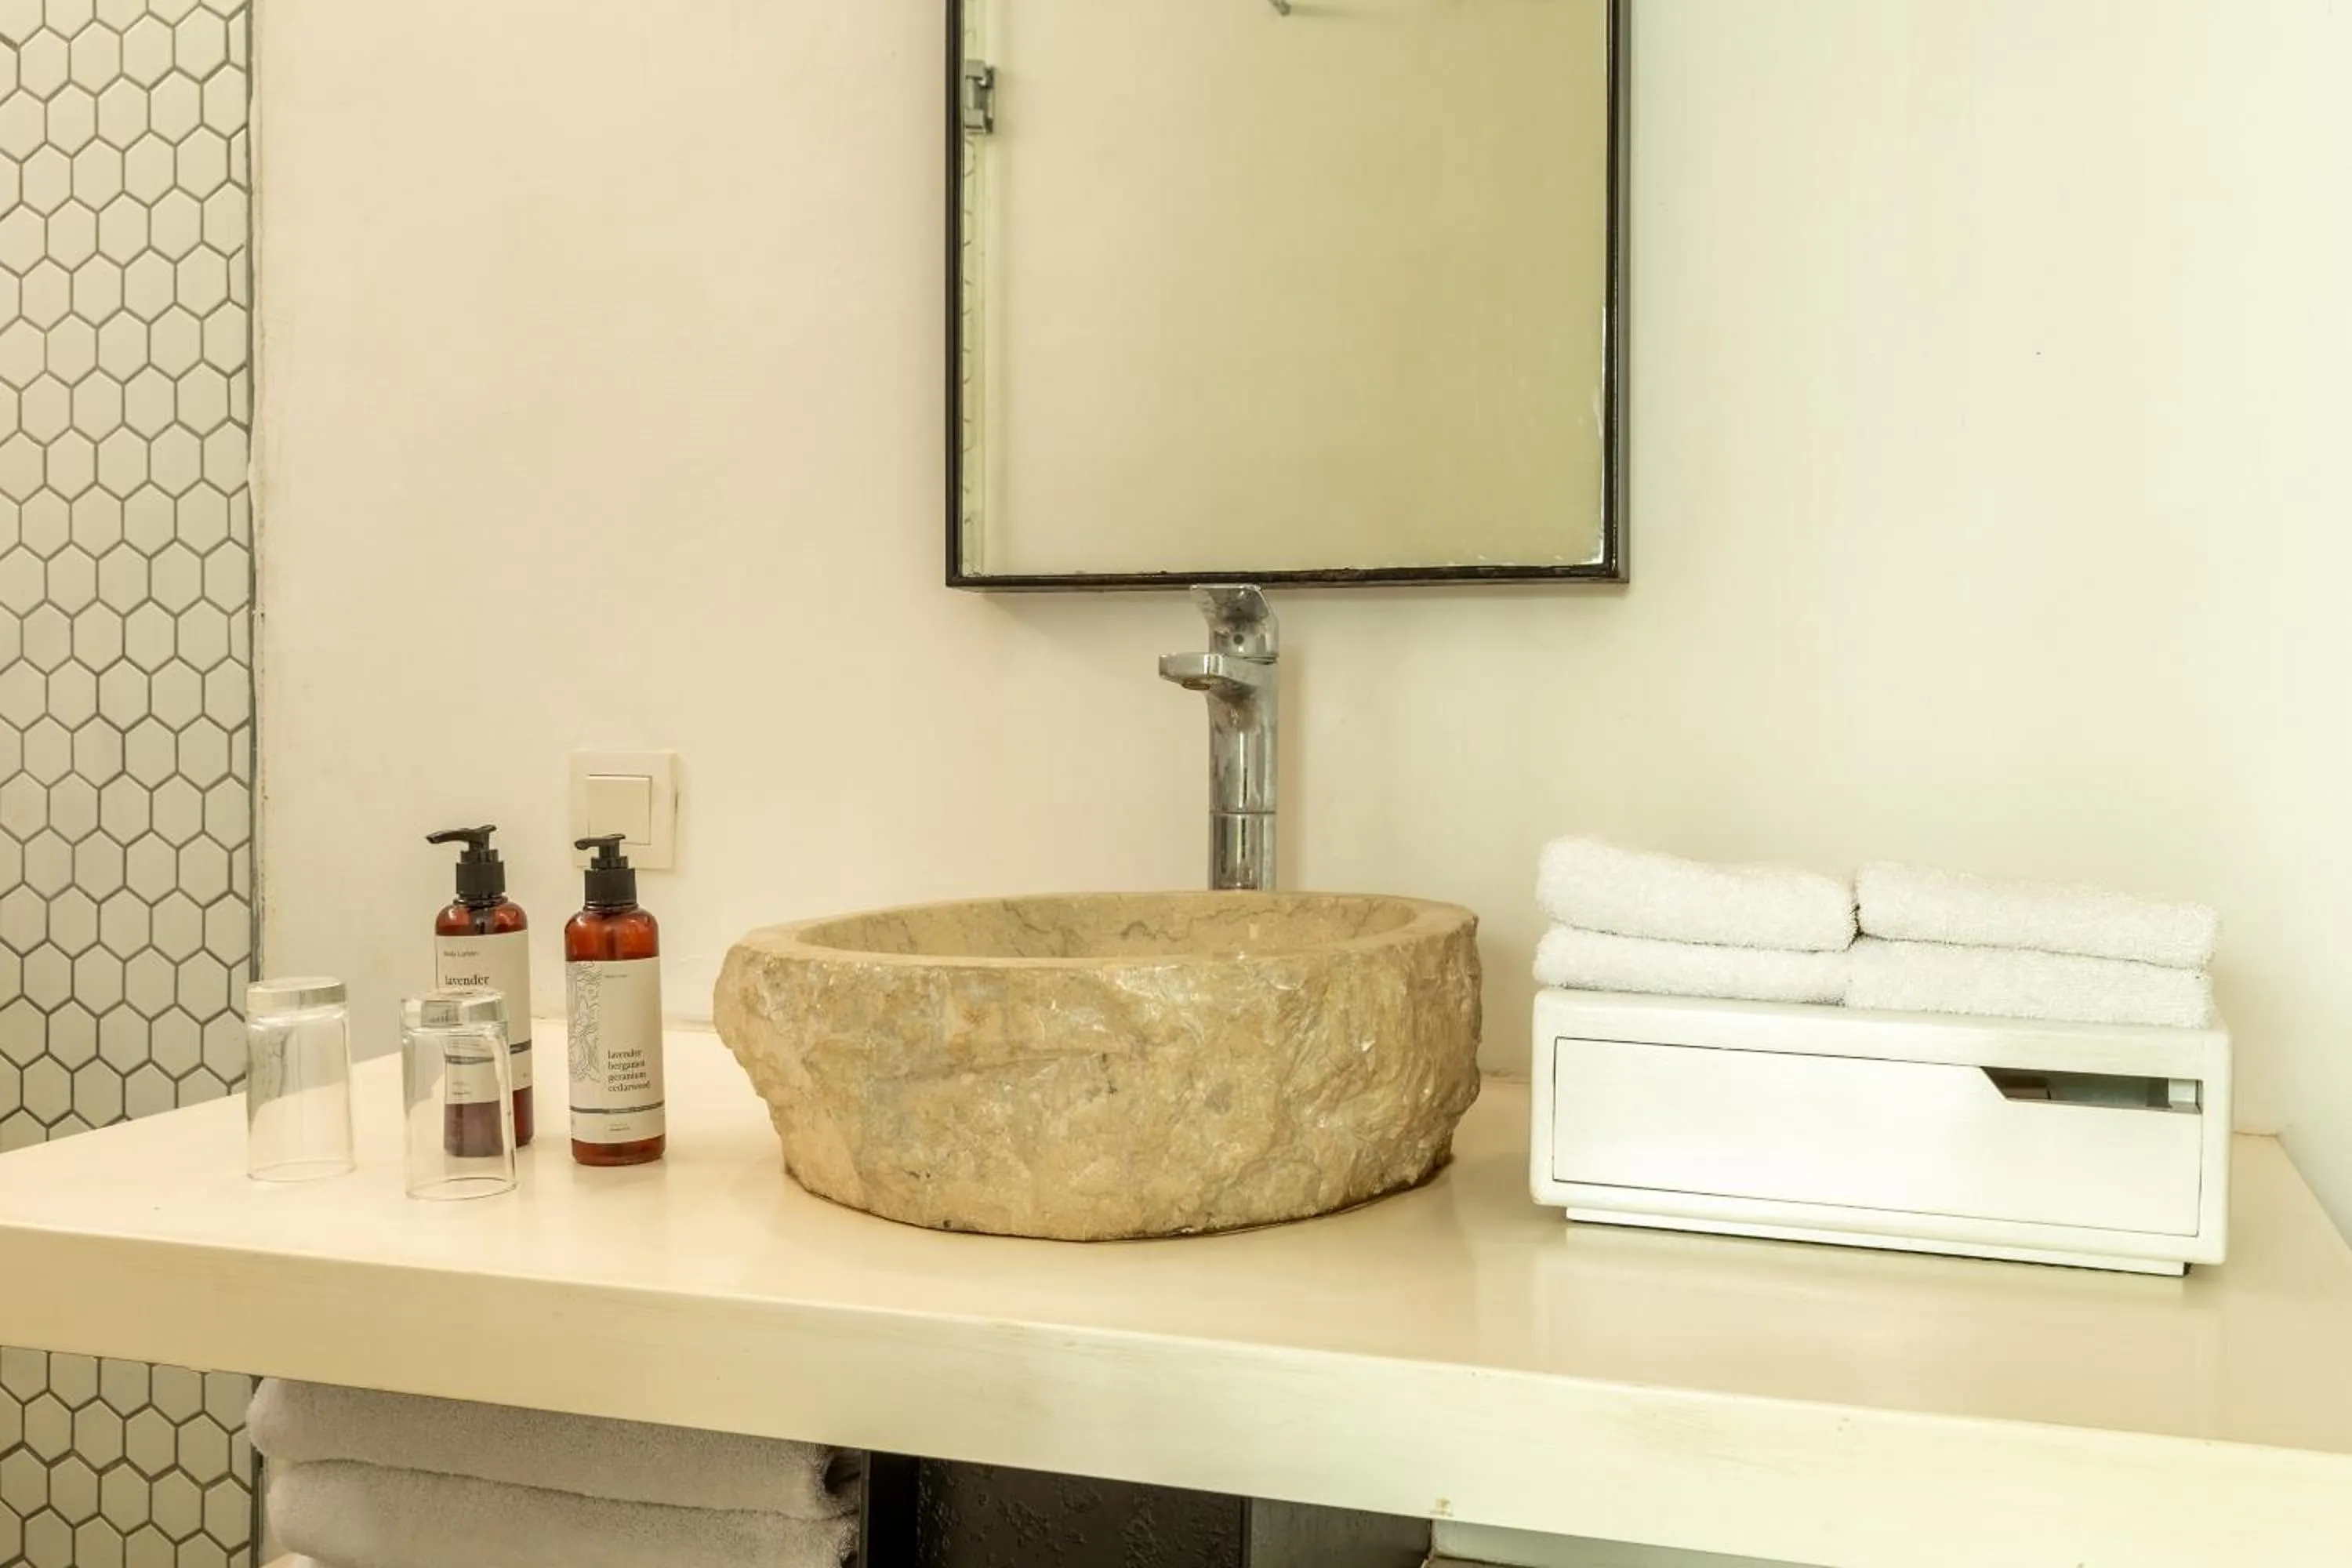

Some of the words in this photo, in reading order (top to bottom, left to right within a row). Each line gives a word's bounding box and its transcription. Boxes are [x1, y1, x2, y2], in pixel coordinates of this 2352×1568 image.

[445, 974, 490, 985] lavender
[608, 1048, 642, 1058] lavender
[608, 1072, 646, 1083] geranium
